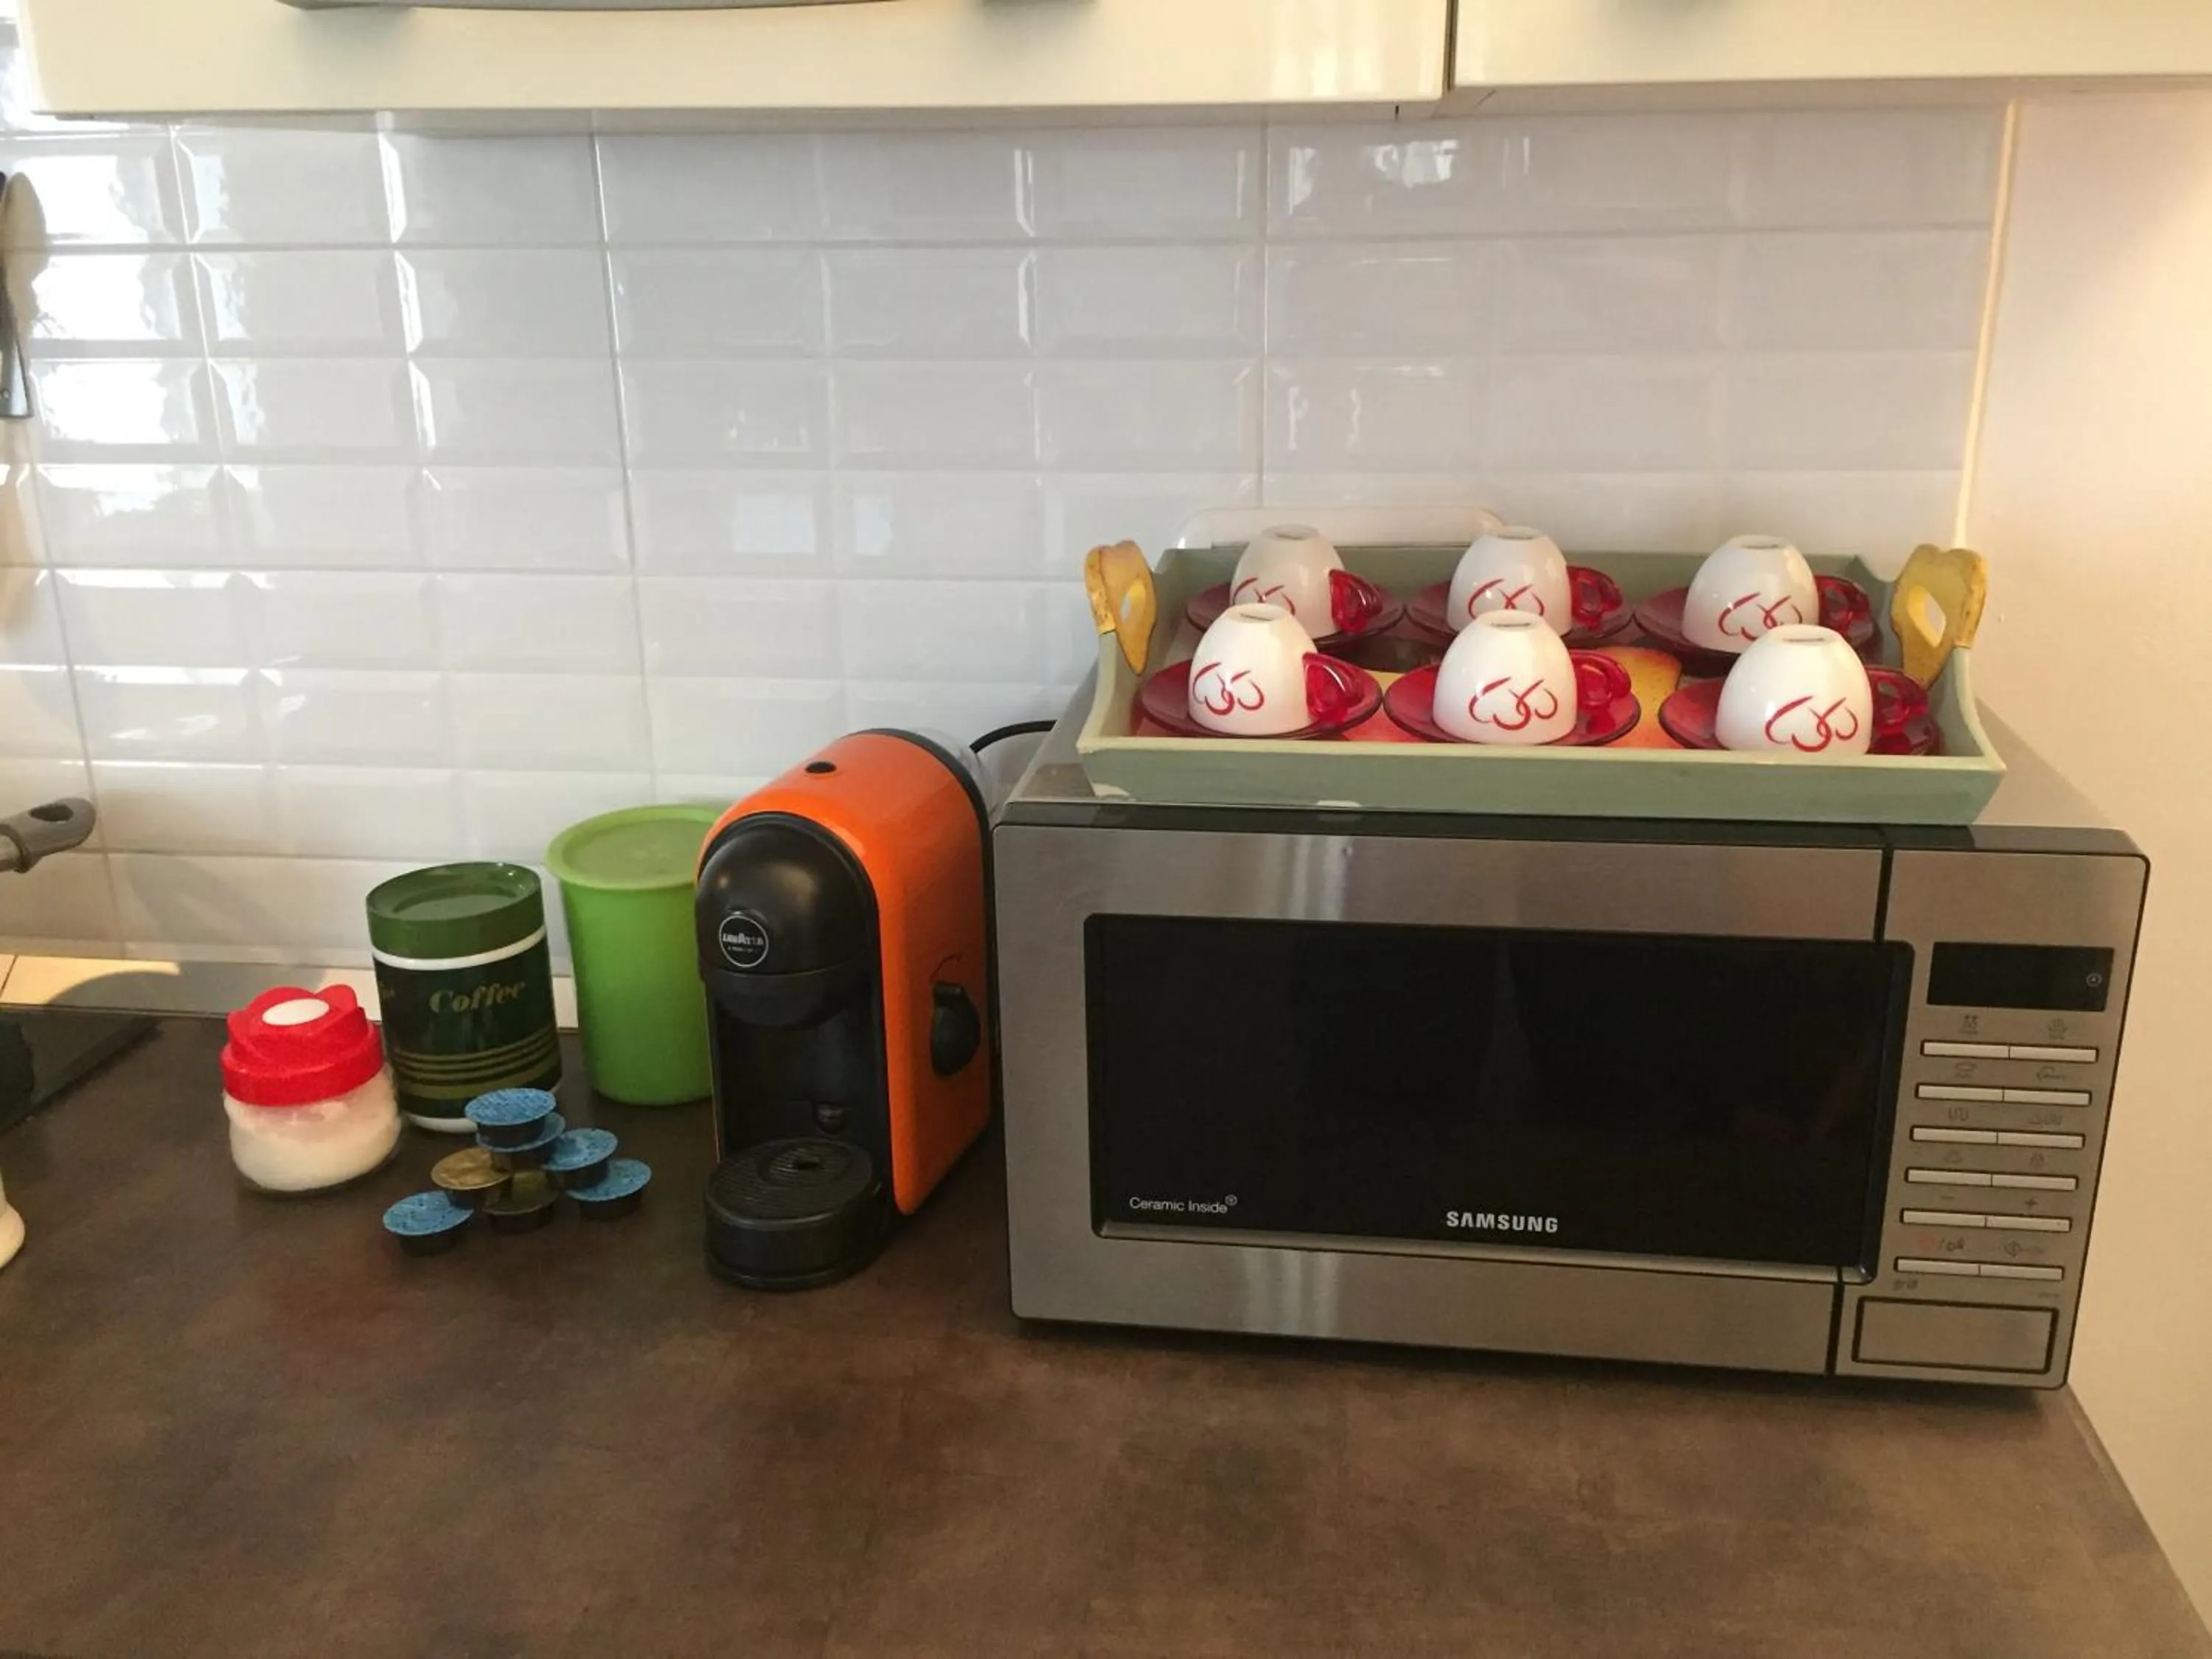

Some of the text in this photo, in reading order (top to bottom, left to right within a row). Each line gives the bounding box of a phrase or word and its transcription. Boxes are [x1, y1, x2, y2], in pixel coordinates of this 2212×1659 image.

[428, 980, 526, 1014] Coffee
[1129, 1196, 1185, 1211] Ceramic
[1446, 1211, 1559, 1234] SAMSUNG
